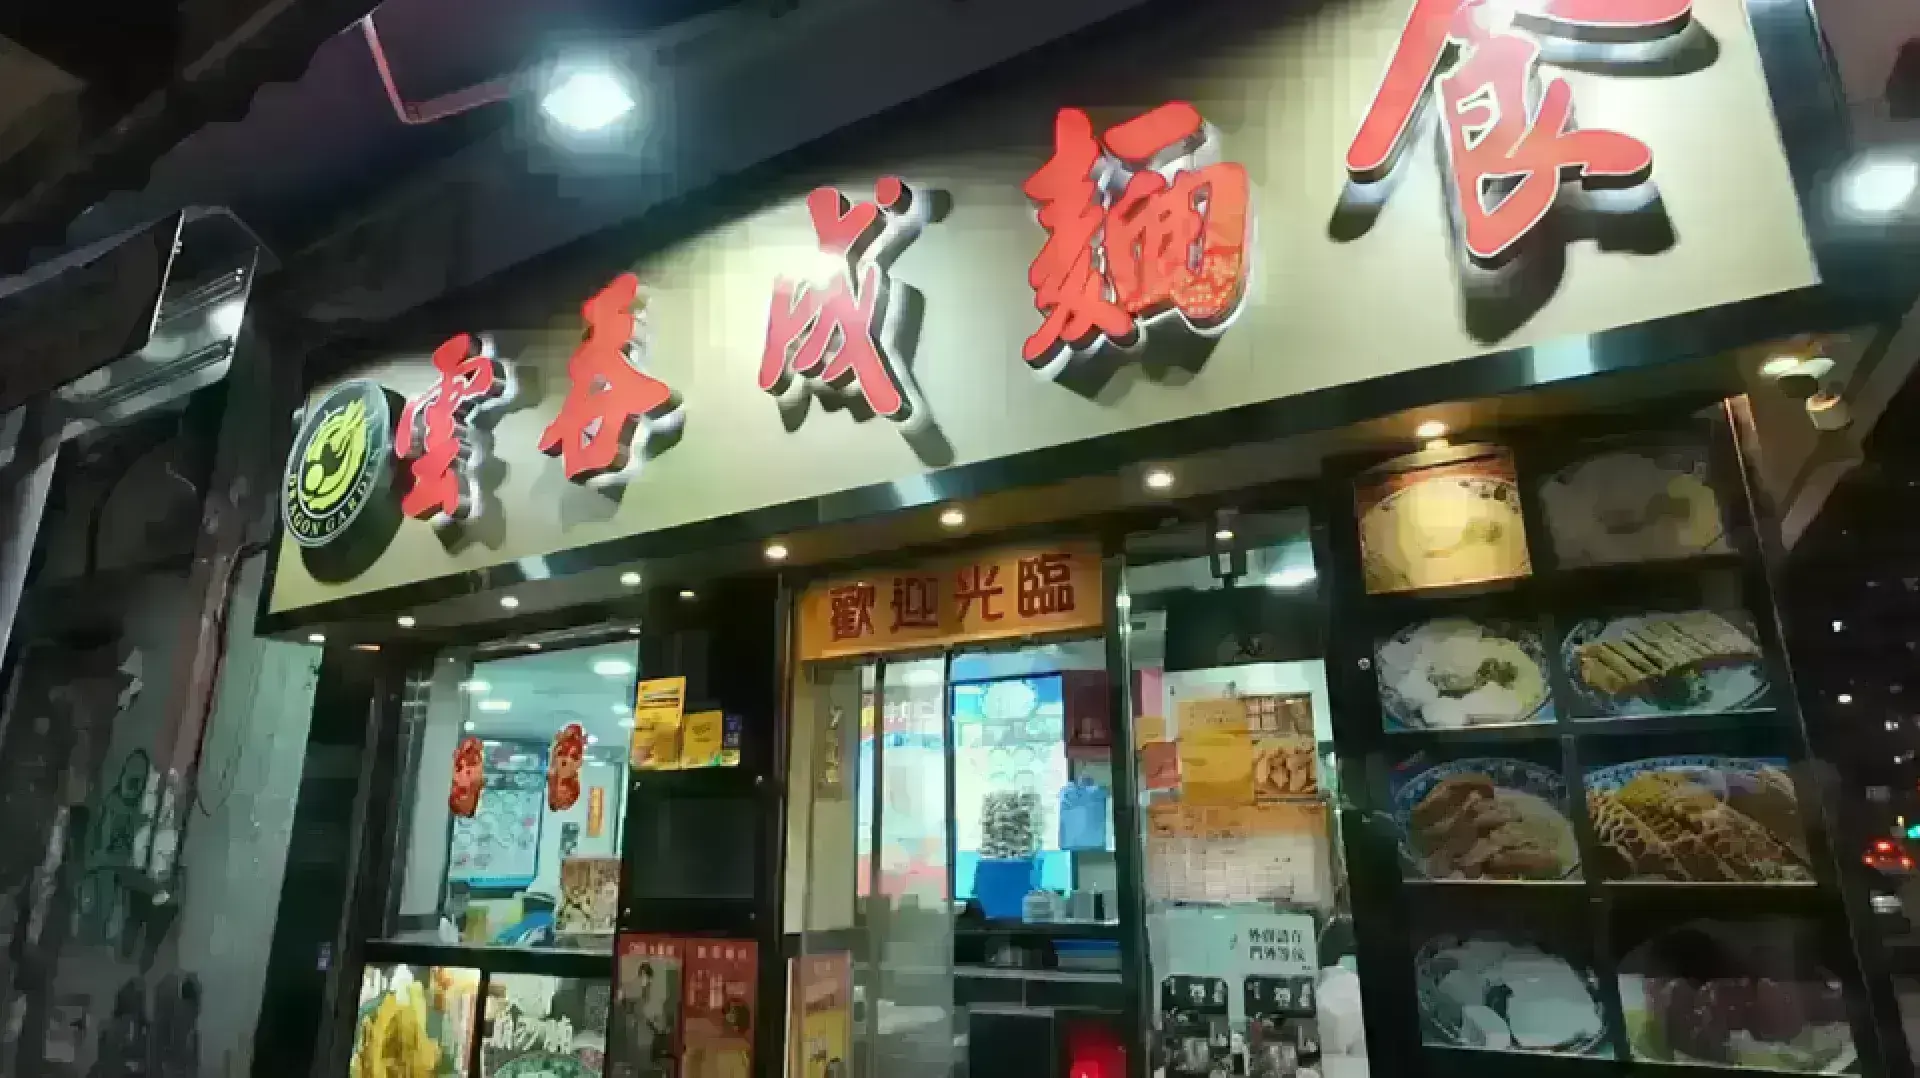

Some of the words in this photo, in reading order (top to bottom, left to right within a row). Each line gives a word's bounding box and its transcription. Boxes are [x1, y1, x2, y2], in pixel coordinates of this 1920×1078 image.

[287, 472, 322, 536] DRAGON
[828, 552, 1075, 642] 歡迎光臨
